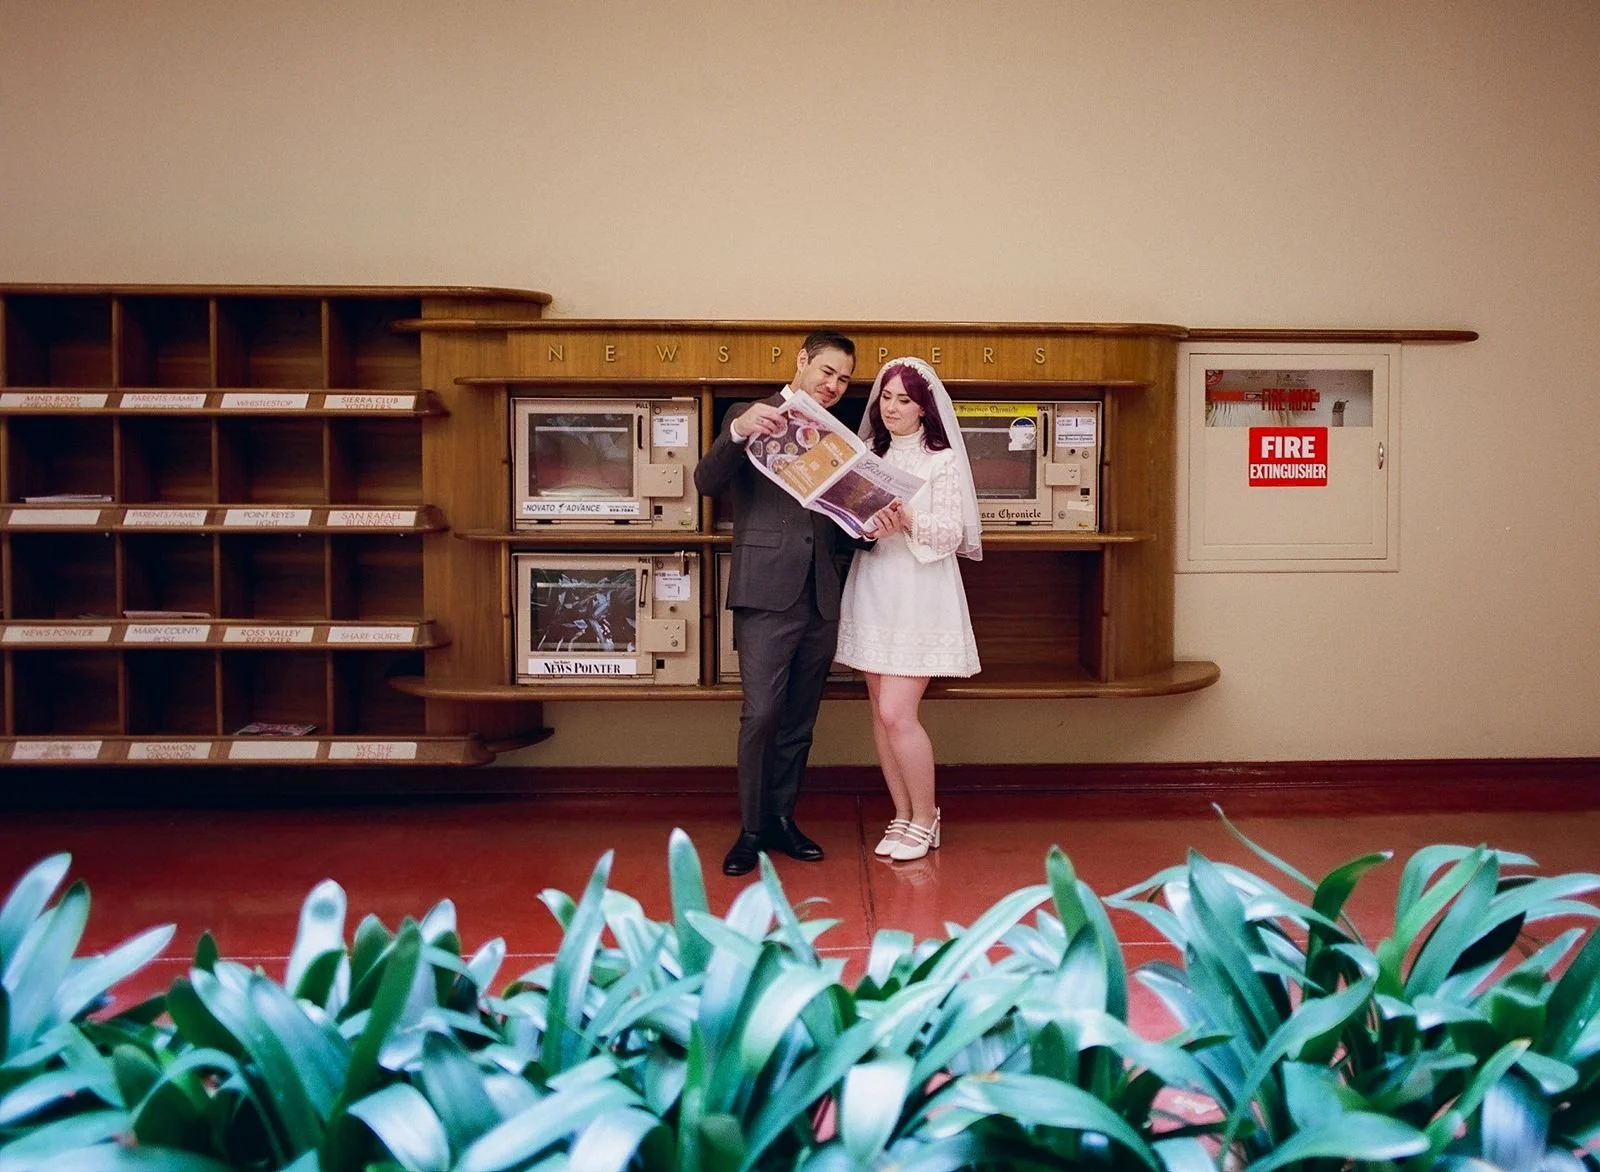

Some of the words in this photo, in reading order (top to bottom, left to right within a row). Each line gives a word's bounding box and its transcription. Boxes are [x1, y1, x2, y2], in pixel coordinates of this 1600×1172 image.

[547, 344, 1046, 364] NEWSPPERS
[236, 399, 294, 407] WHISTLESTOP
[1261, 436, 1316, 459] FIRE
[1250, 463, 1327, 479] EXTINGUISHER
[526, 504, 556, 512] NOVATO
[565, 504, 601, 512] ADVANCE
[341, 512, 365, 520] SAN
[367, 512, 401, 520] RAFAEL
[998, 508, 1042, 519] Chronicle
[21, 629, 51, 637] NEWS
[53, 629, 94, 637] POINTER
[164, 627, 200, 635] COUNTY
[240, 629, 266, 637] ROSS
[268, 629, 301, 637] VALLEY
[341, 632, 369, 640] SHARE
[372, 632, 401, 640] GUIDE
[356, 744, 372, 752] WE
[377, 744, 393, 752] THE
